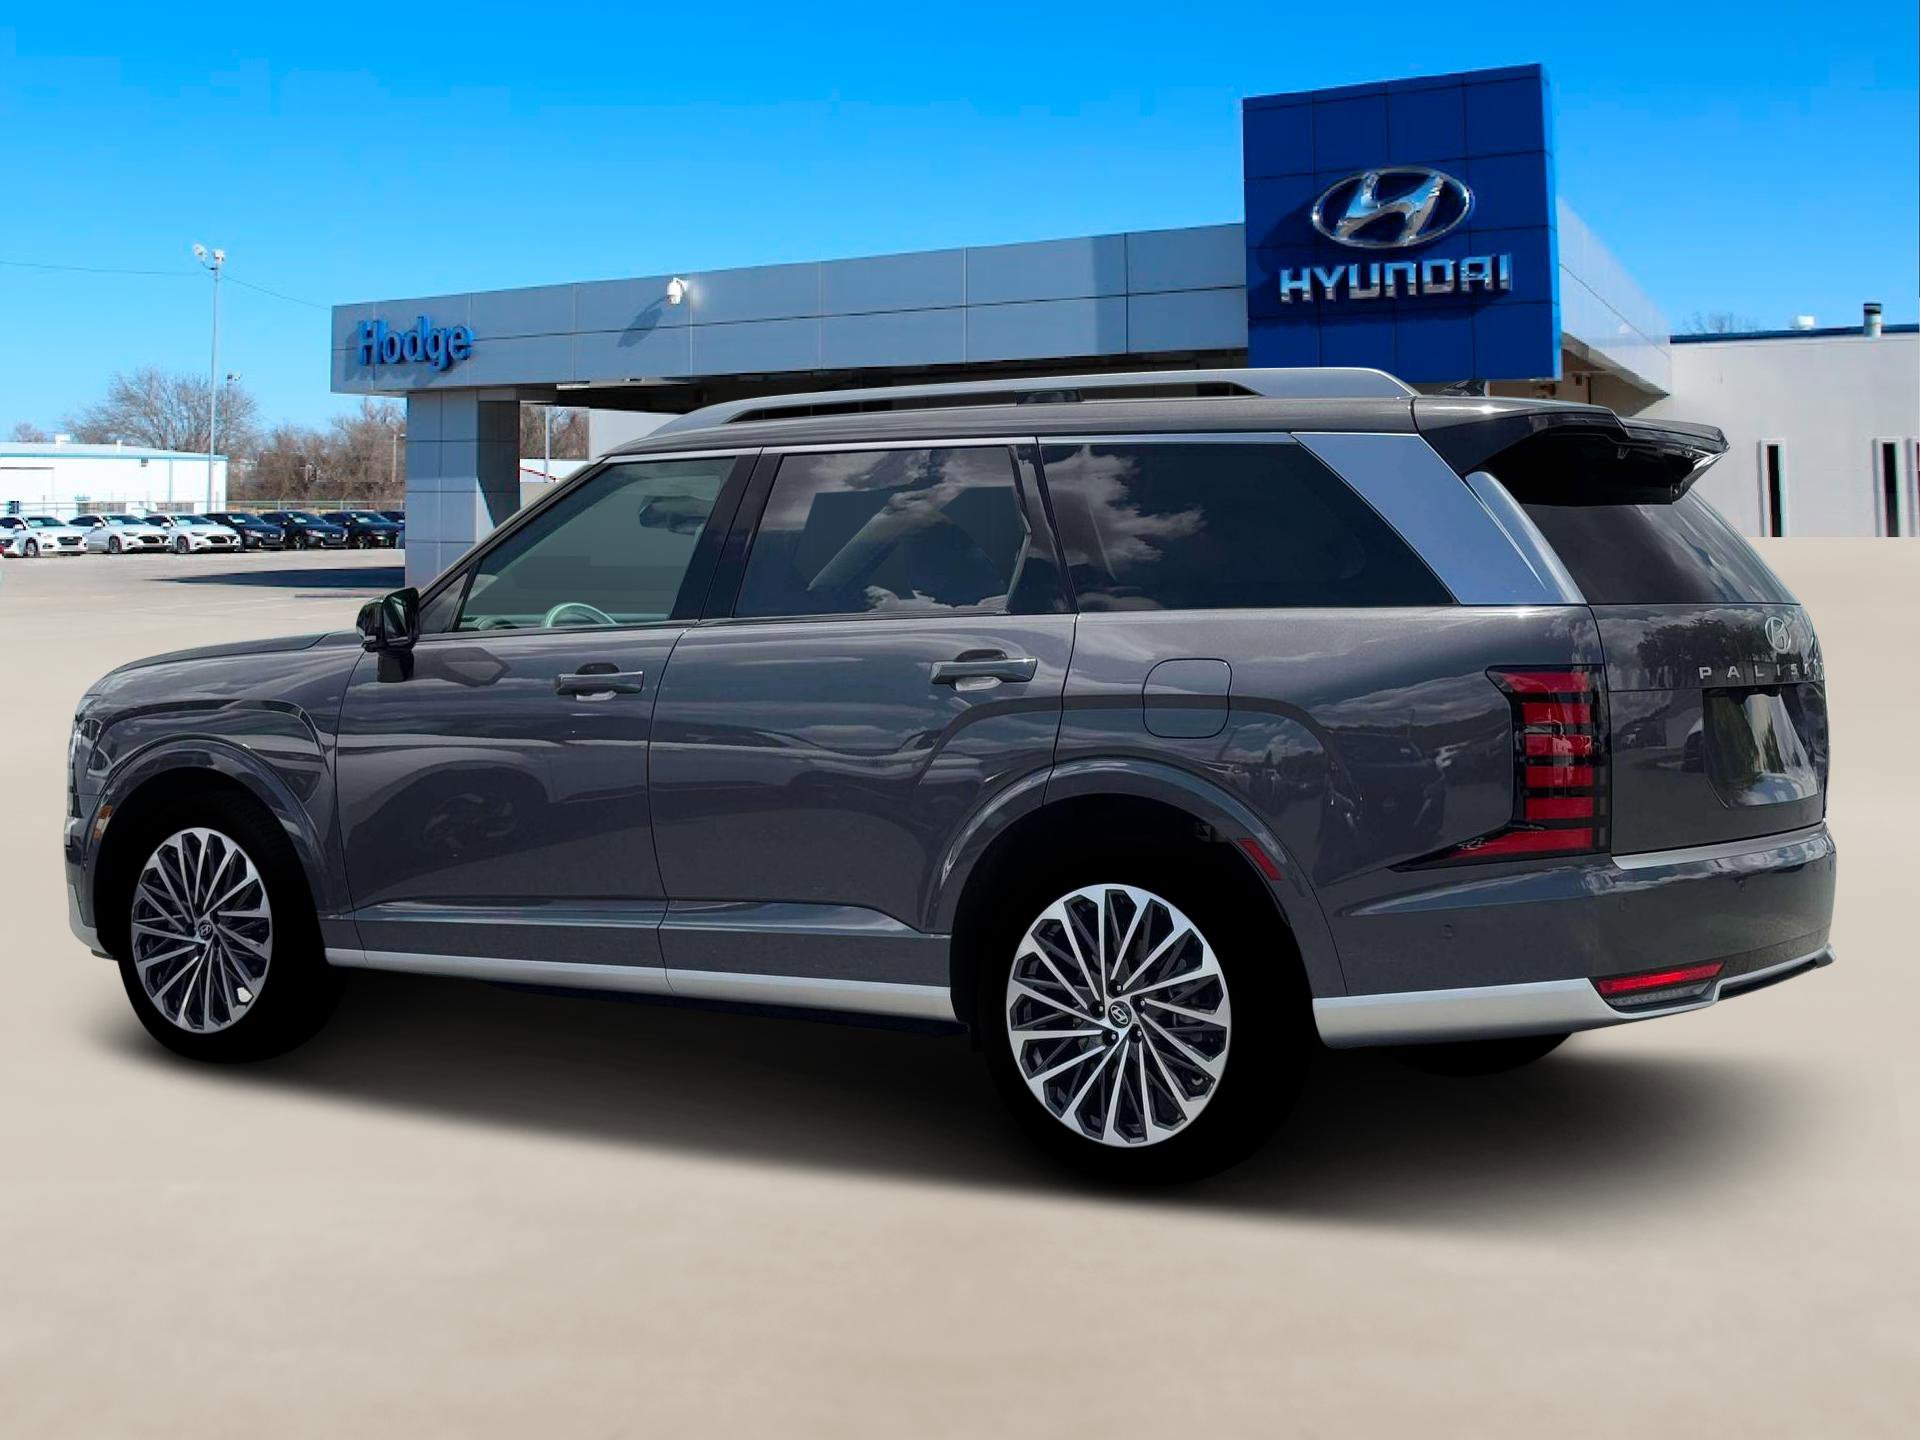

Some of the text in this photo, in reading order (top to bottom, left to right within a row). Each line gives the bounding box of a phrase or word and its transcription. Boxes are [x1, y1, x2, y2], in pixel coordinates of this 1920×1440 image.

[1279, 253, 1512, 304] HYUNDAI
[358, 315, 474, 371] Hodge
[1698, 662, 1822, 680] PALIS
